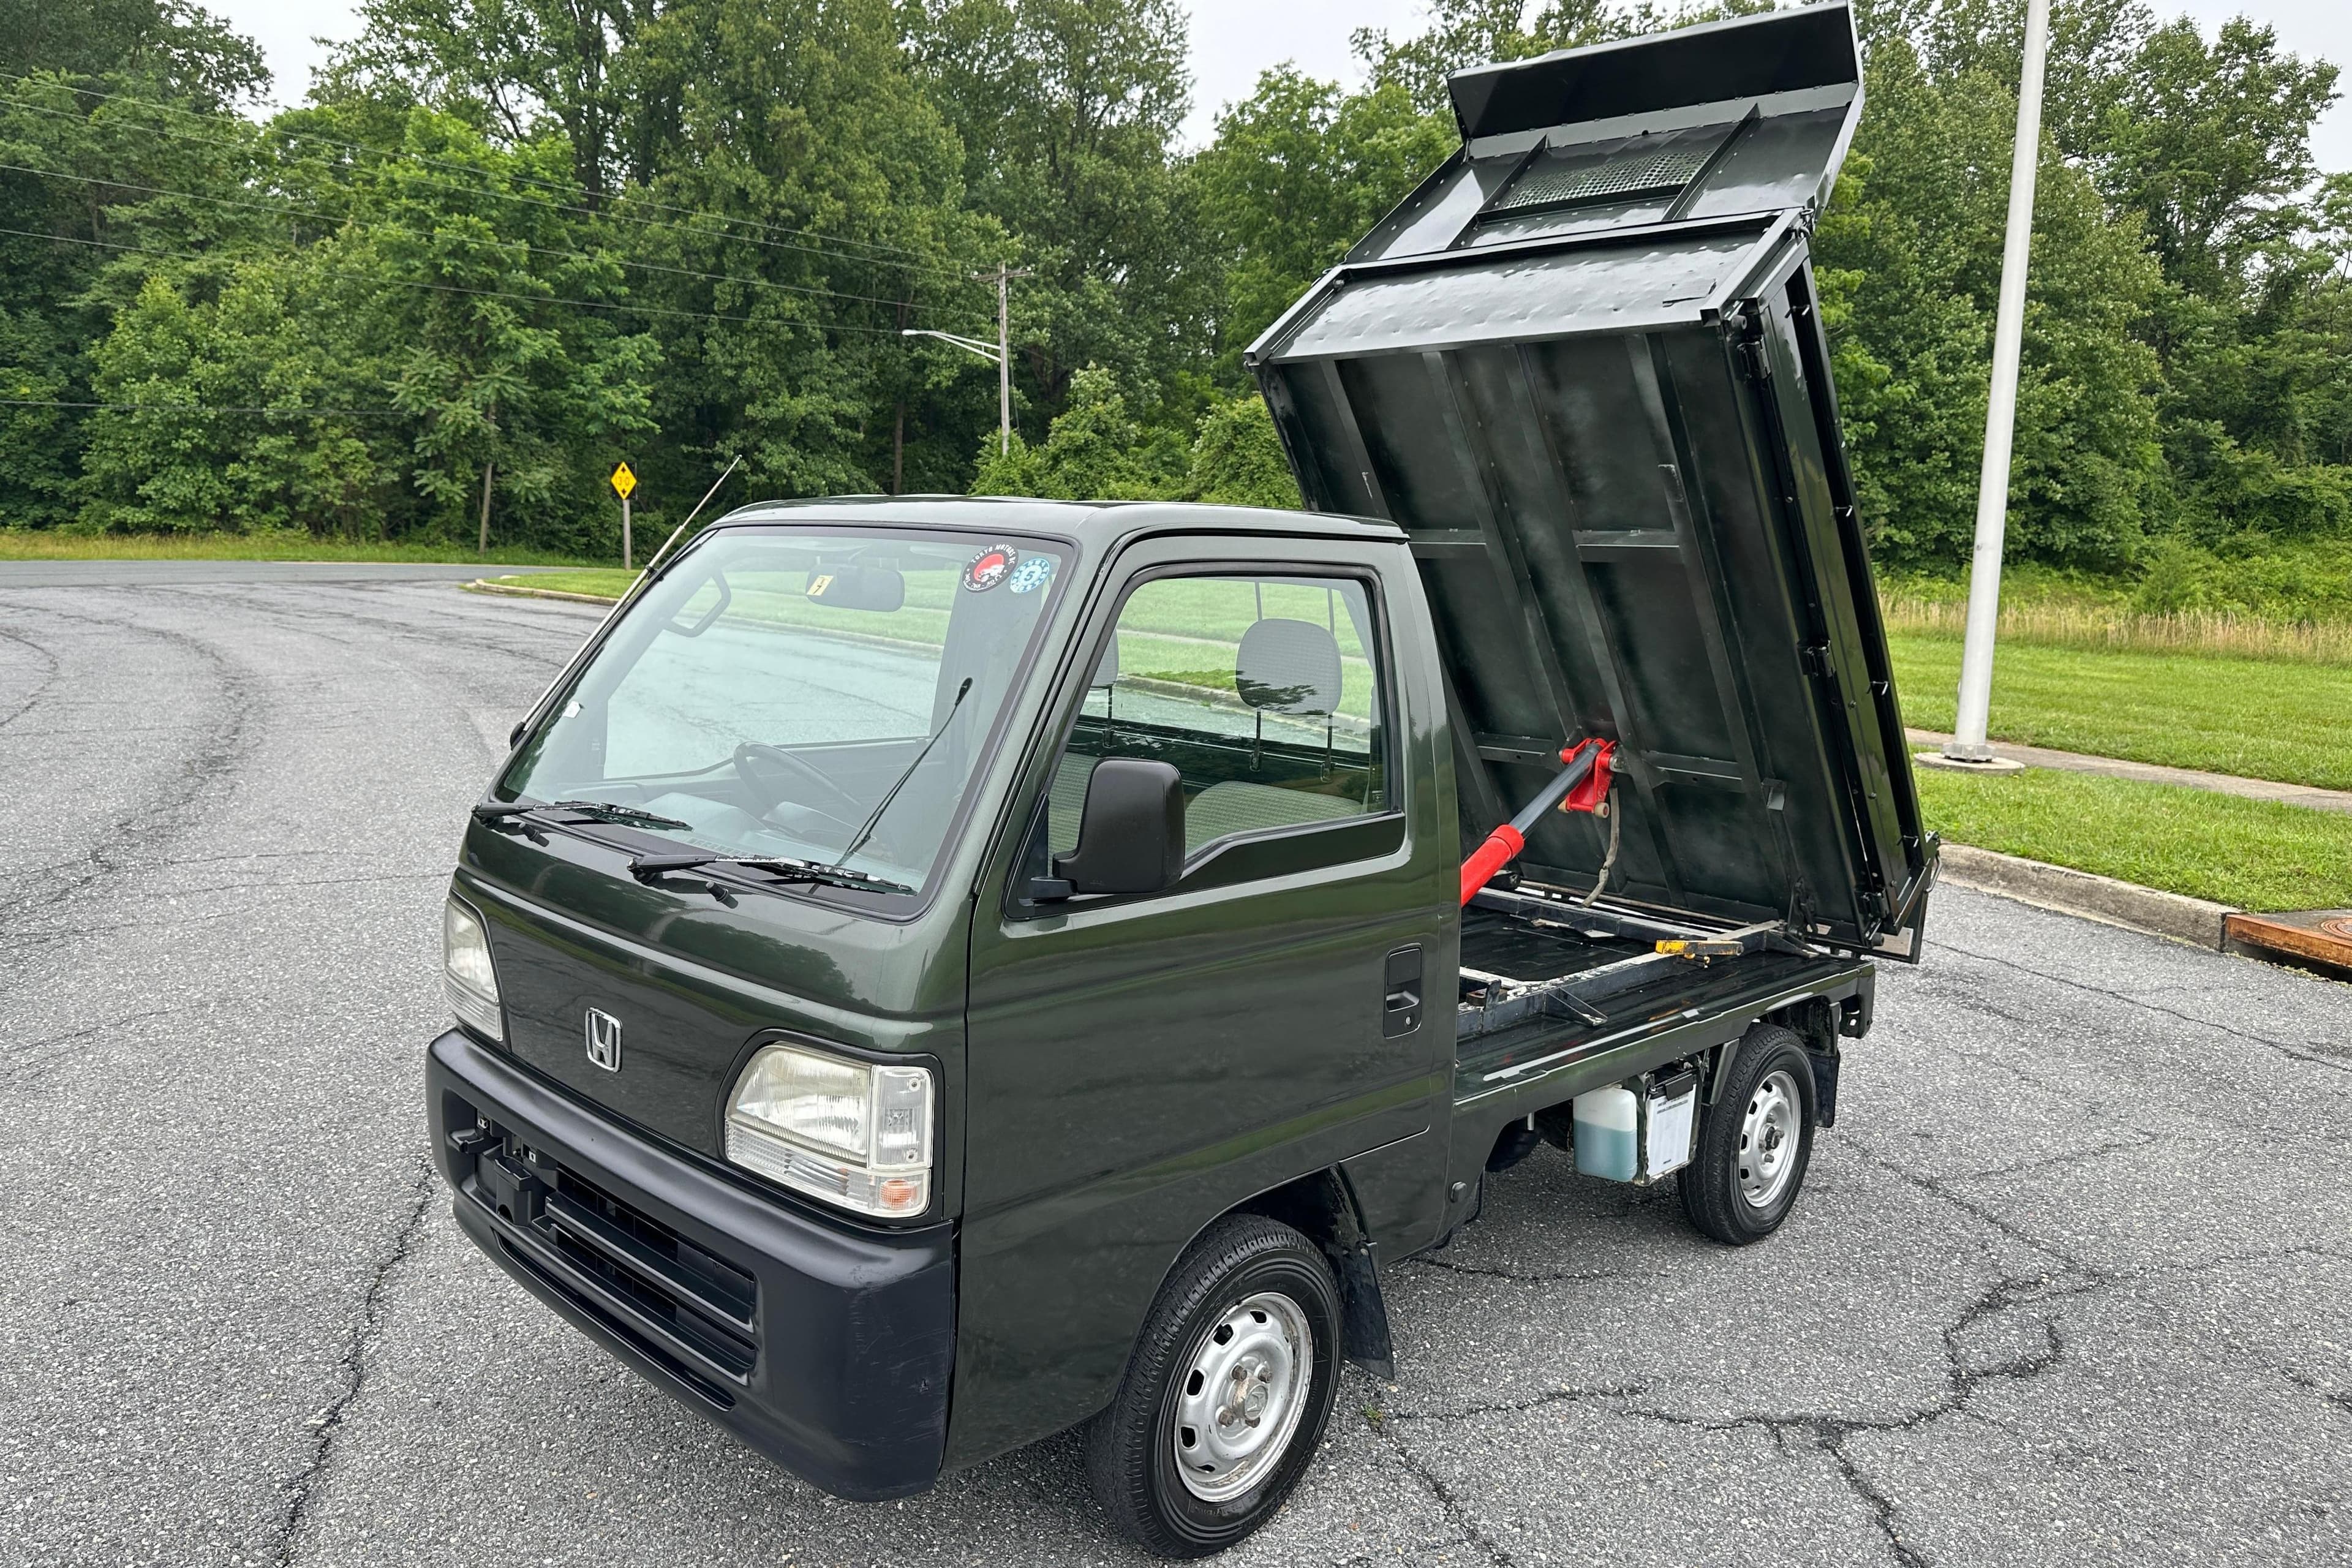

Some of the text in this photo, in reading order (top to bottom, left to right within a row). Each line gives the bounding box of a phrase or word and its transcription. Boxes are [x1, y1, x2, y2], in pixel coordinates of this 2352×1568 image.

[971, 546, 993, 563] TOKYO
[995, 544, 1016, 557] MOTORS
[1023, 571, 1035, 582] 5
